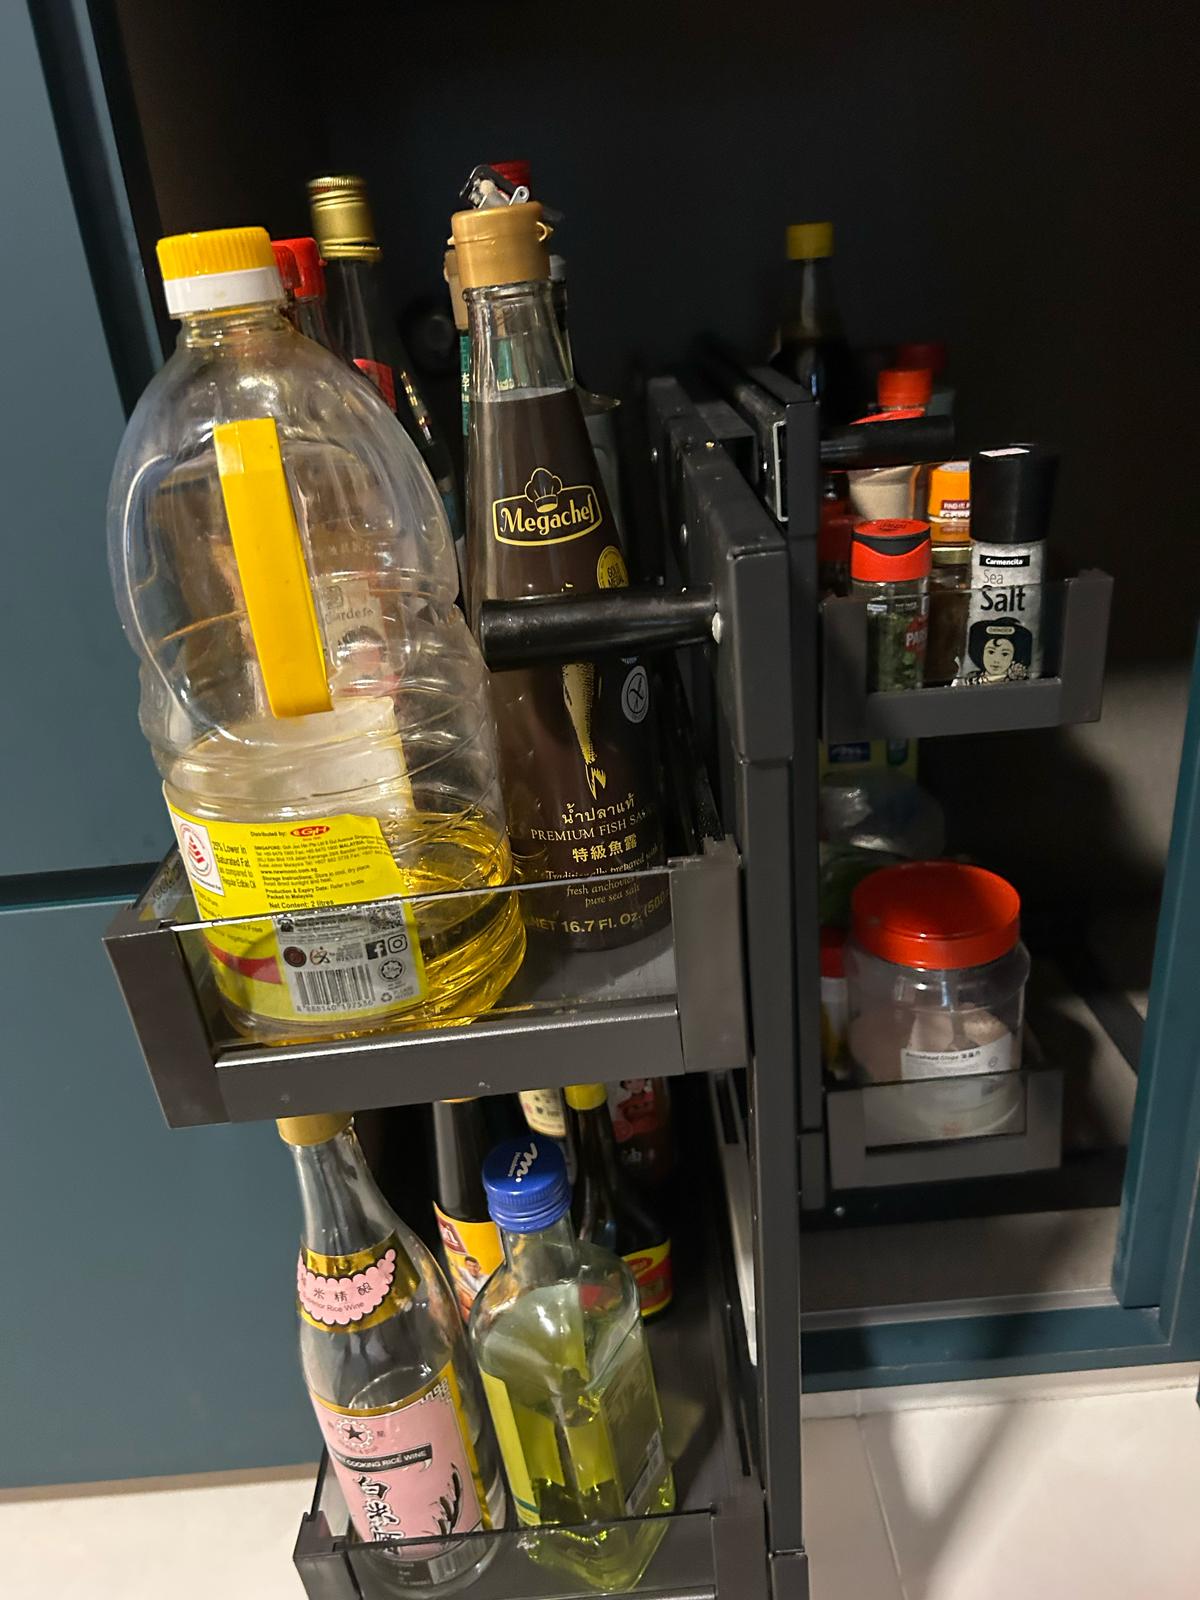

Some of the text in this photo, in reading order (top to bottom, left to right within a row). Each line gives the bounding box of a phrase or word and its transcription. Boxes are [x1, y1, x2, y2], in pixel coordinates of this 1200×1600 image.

[500, 493, 595, 536] Megachef
[985, 557, 1024, 566] Carmencita
[983, 569, 1004, 584] Sea
[980, 585, 1026, 612] Salt
[561, 792, 635, 824] น้ำปลาแท้
[530, 827, 595, 842] PREMIUM
[599, 819, 627, 837] FISH
[572, 833, 637, 863] 特級魚露
[566, 884, 589, 897] fresh
[585, 882, 640, 908] pure sea salt
[561, 919, 595, 933] 16.7
[599, 918, 617, 931] Fl.
[620, 911, 641, 926] Oz.
[326, 1303, 343, 1313] Rice
[344, 1301, 365, 1311] Wine
[346, 1458, 382, 1468] COOKING
[382, 1455, 402, 1466] RICE
[404, 1451, 428, 1462] WINE
